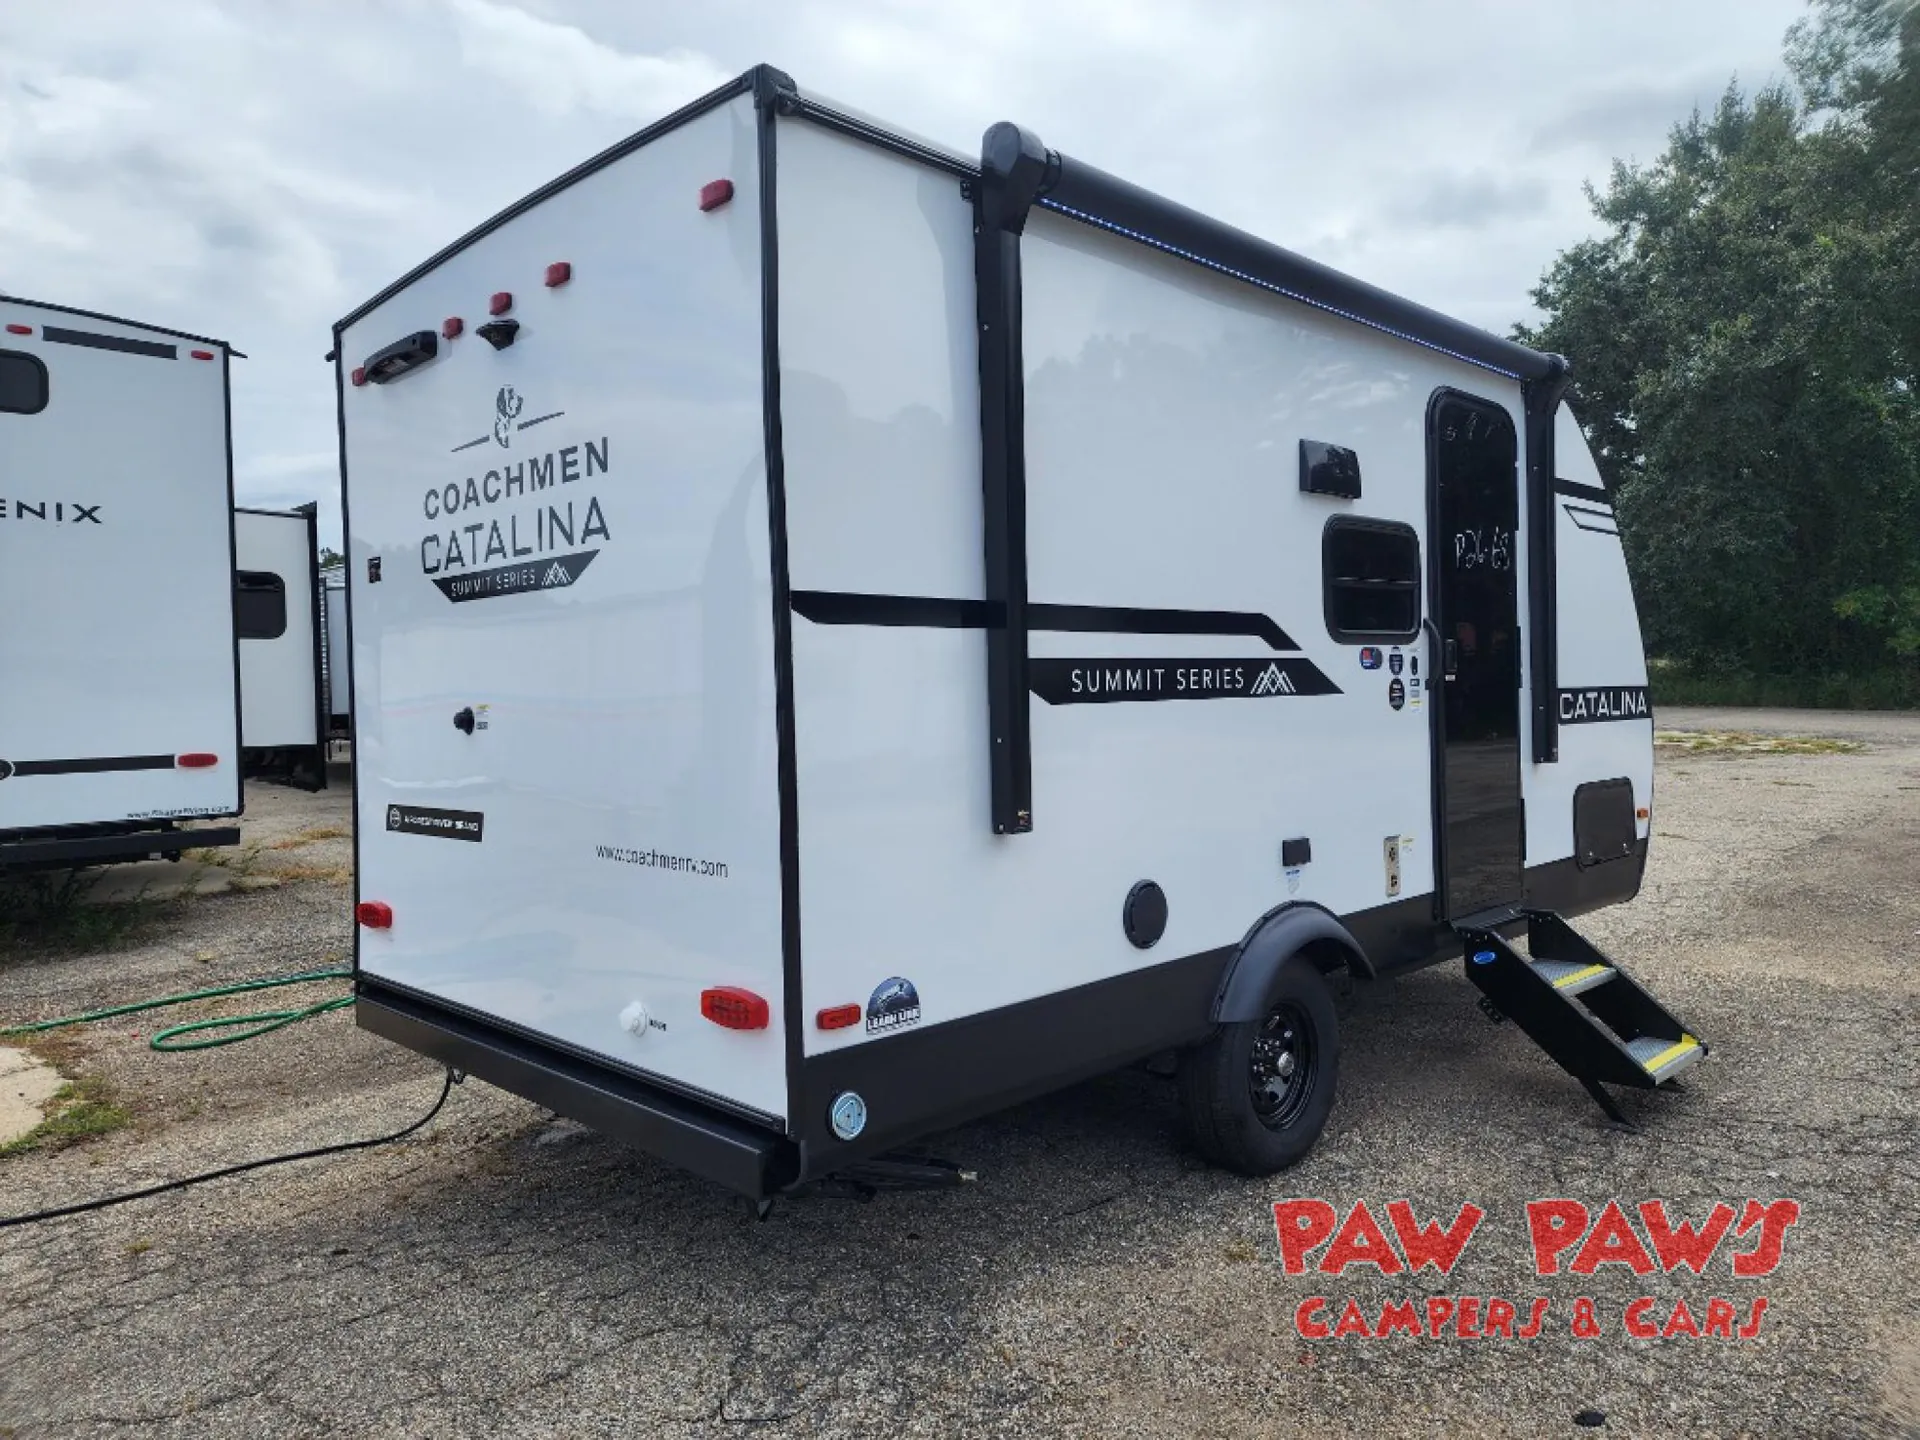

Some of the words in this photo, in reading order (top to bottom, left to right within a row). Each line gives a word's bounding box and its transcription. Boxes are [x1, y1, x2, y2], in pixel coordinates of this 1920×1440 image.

[424, 437, 609, 520] COACHMEN
[421, 496, 610, 575] CATALINA
[451, 575, 492, 597] SUMMIT
[496, 569, 536, 589] SERIES
[1071, 668, 1165, 693] SUMMIT
[1176, 667, 1244, 690] SERIES
[1560, 691, 1647, 719] CATALINA
[595, 845, 728, 878] www.coachmenrv.com
